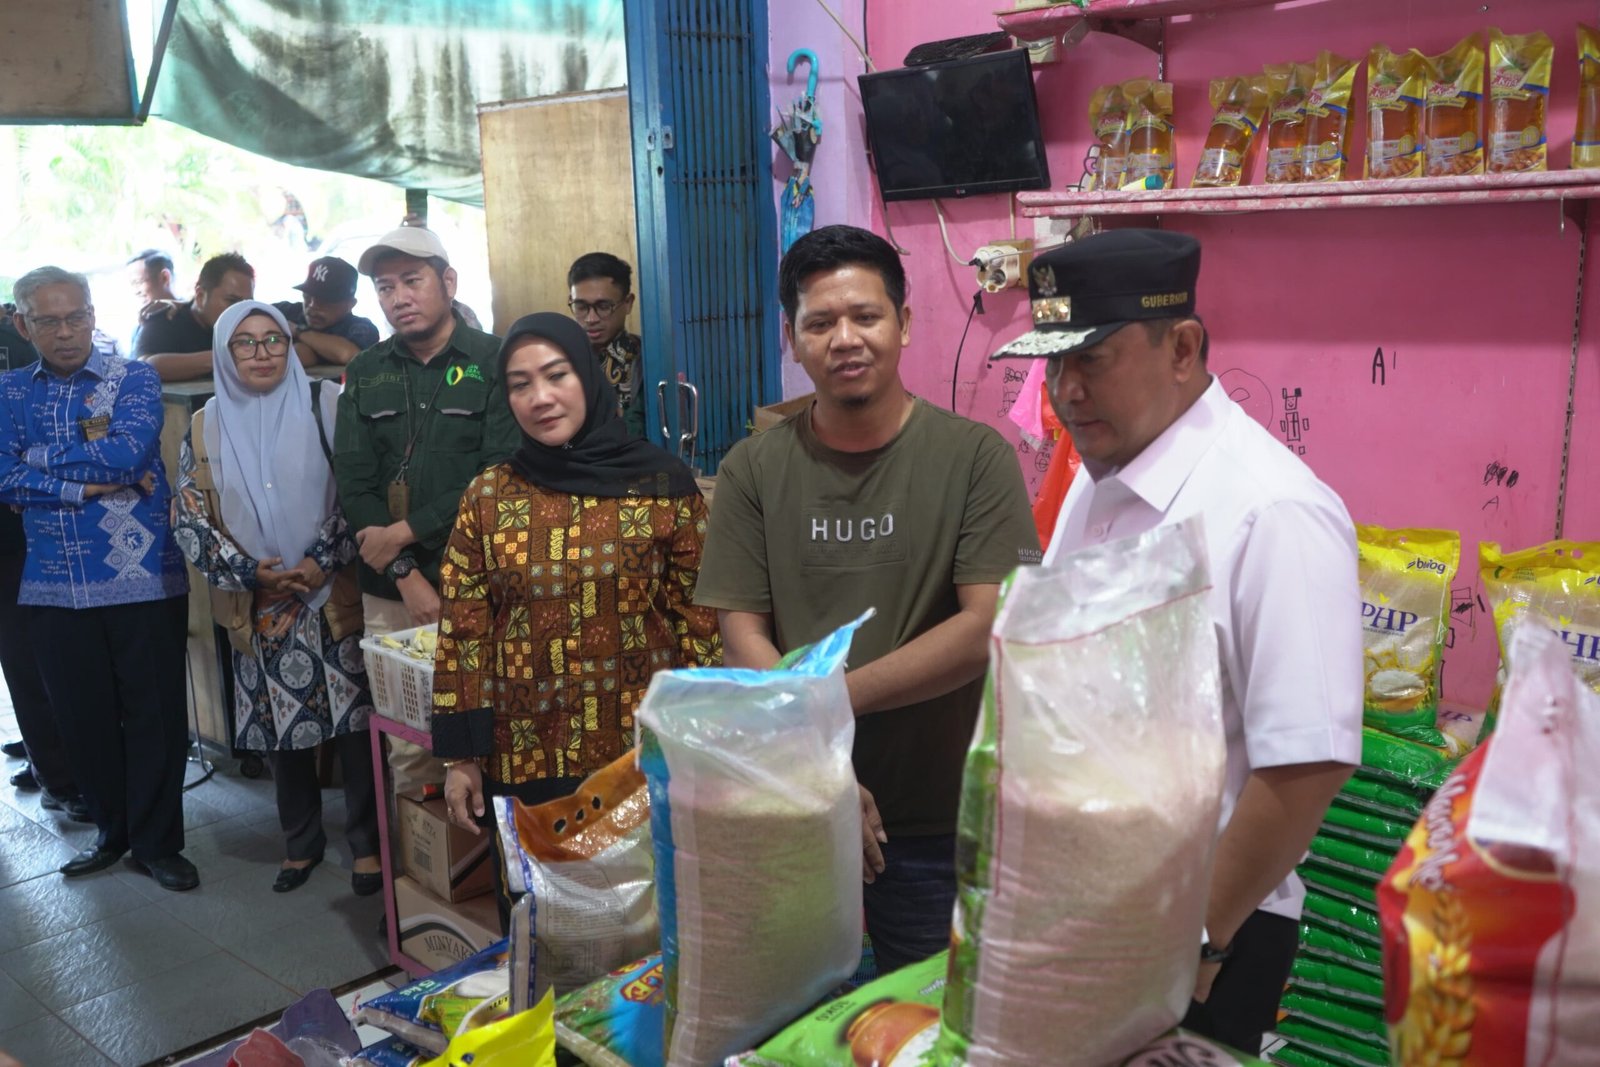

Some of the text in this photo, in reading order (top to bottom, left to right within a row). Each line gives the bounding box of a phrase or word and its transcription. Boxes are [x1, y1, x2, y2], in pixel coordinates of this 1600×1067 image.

[1371, 346, 1386, 386] A
[810, 512, 895, 542] HUGO
[1361, 601, 1419, 633] PHP
